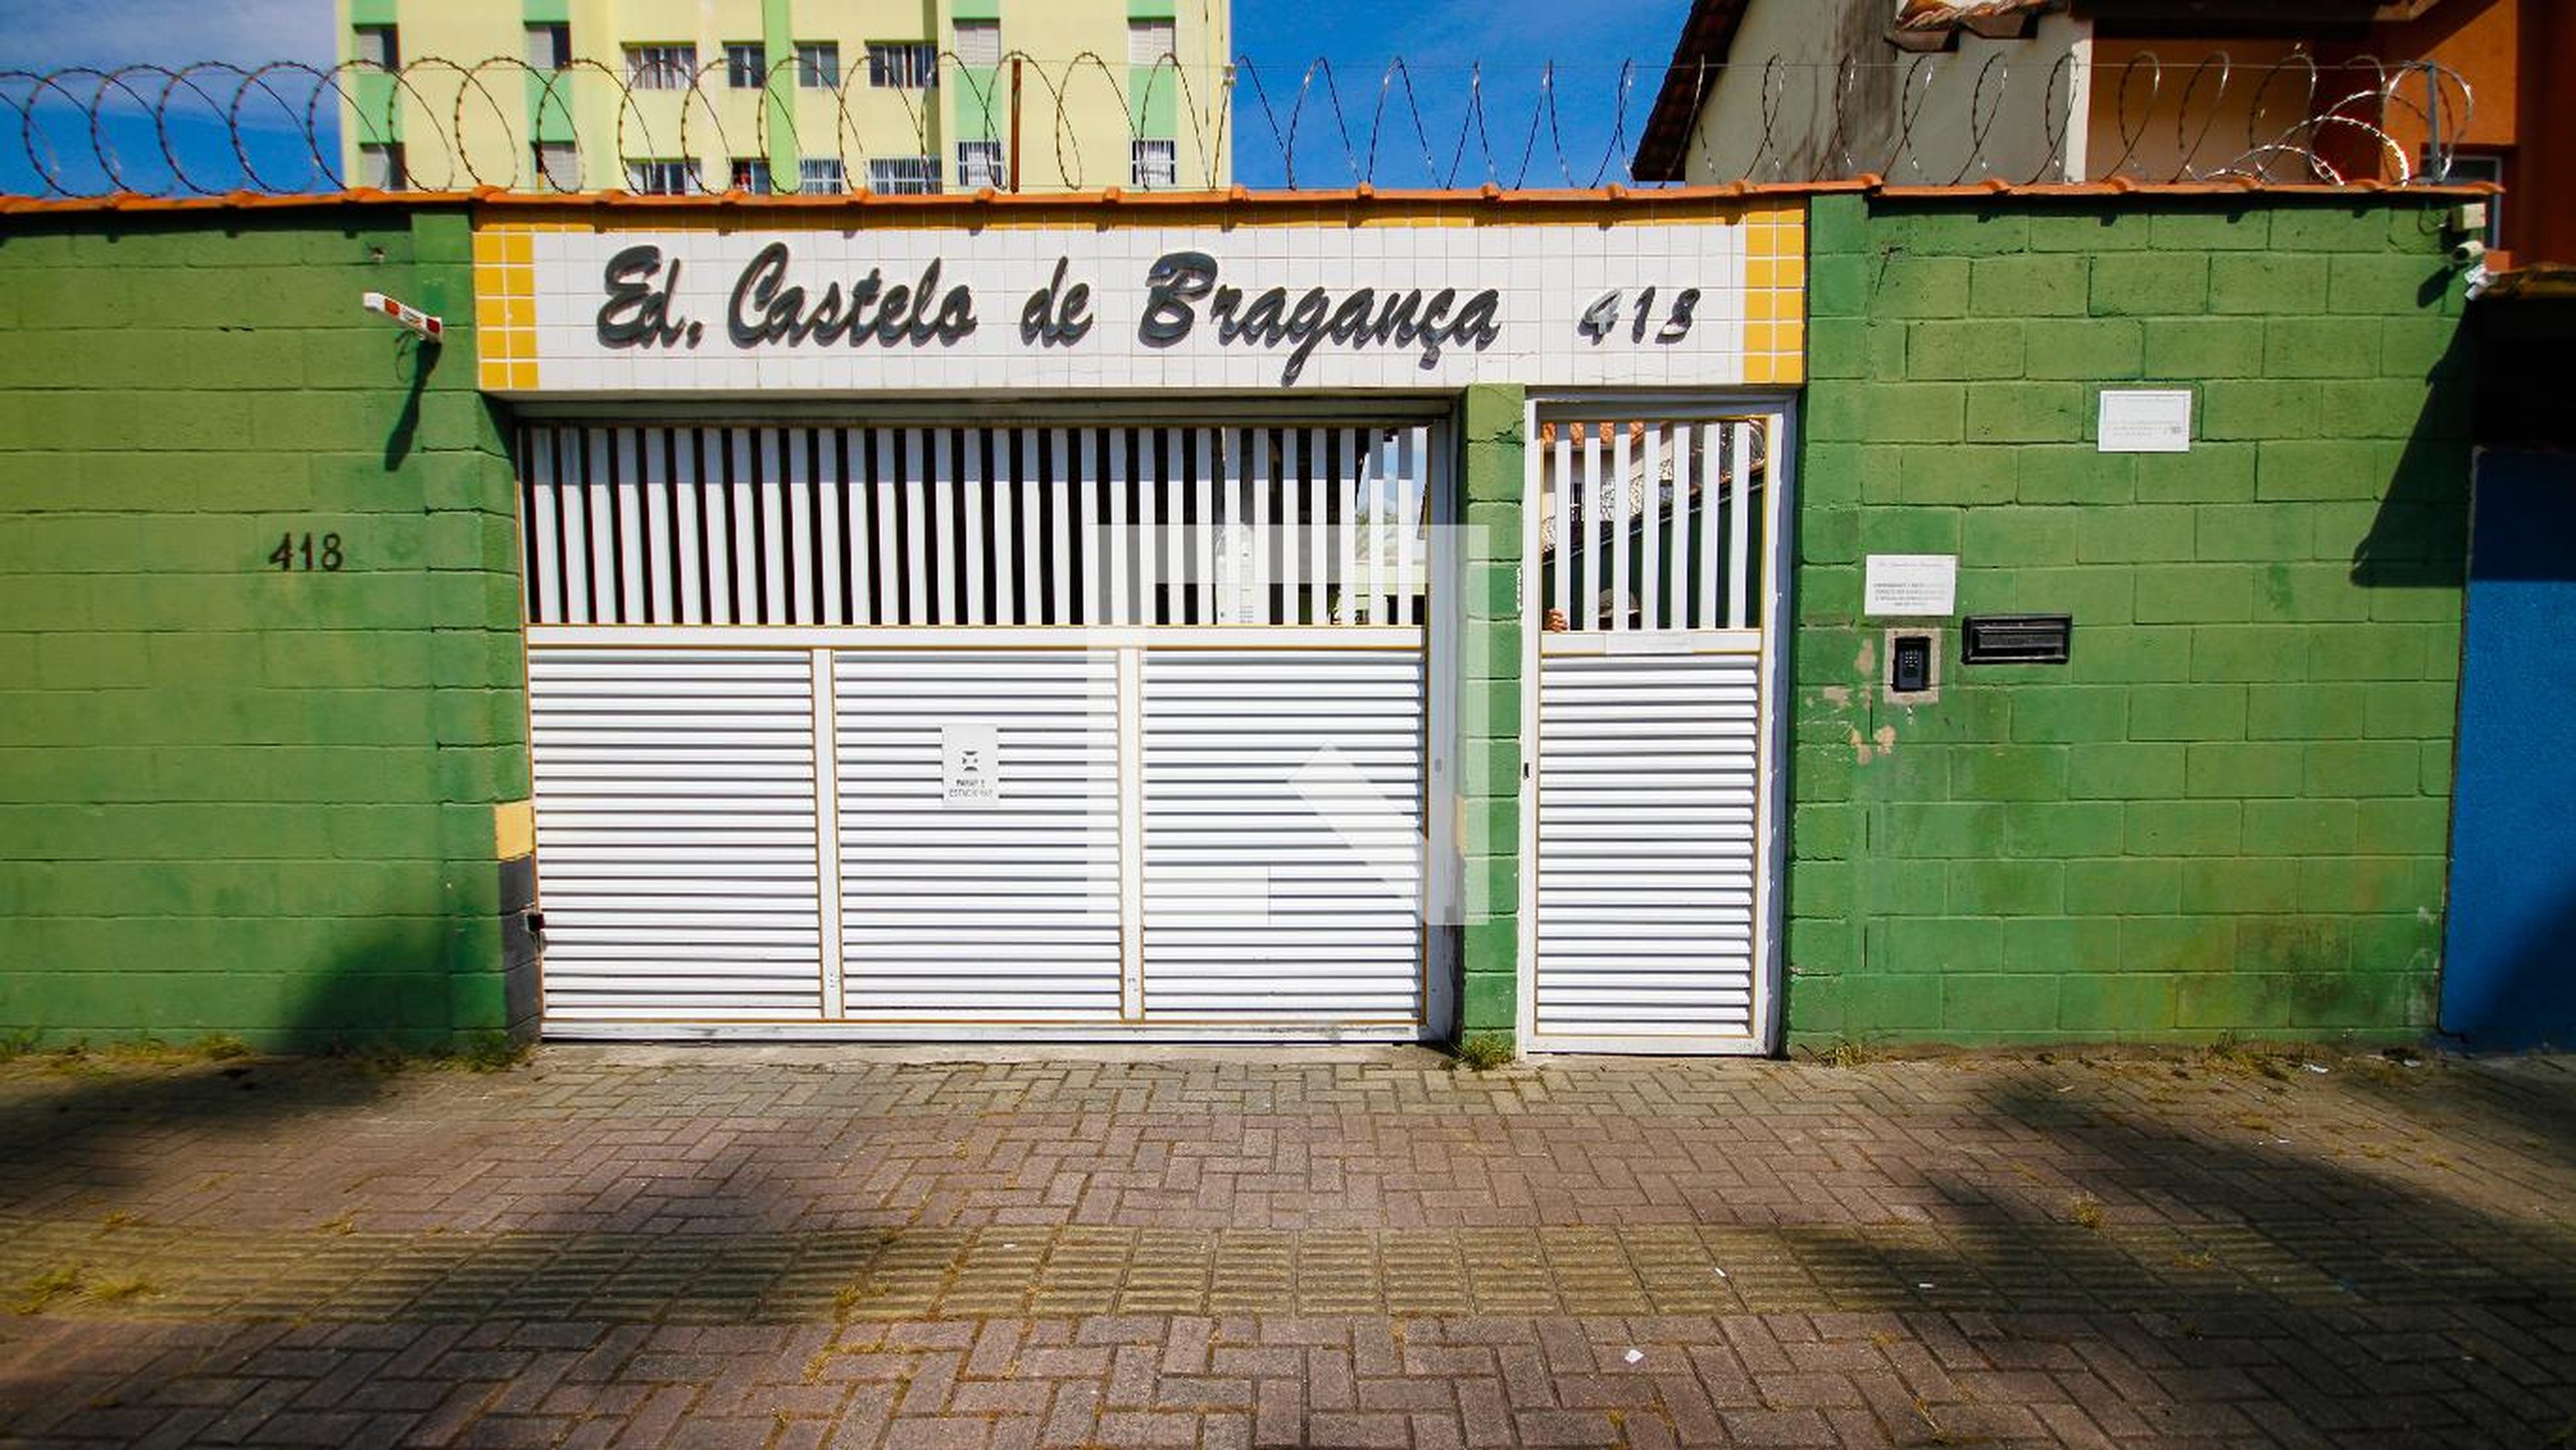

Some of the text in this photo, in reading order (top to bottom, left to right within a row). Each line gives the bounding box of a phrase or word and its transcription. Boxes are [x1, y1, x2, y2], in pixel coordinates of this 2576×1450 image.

[597, 244, 703, 348] Ed.
[727, 242, 977, 349] Castelo
[1020, 256, 1093, 347] de
[1138, 251, 1501, 387] Bragança
[269, 533, 343, 571] 418
